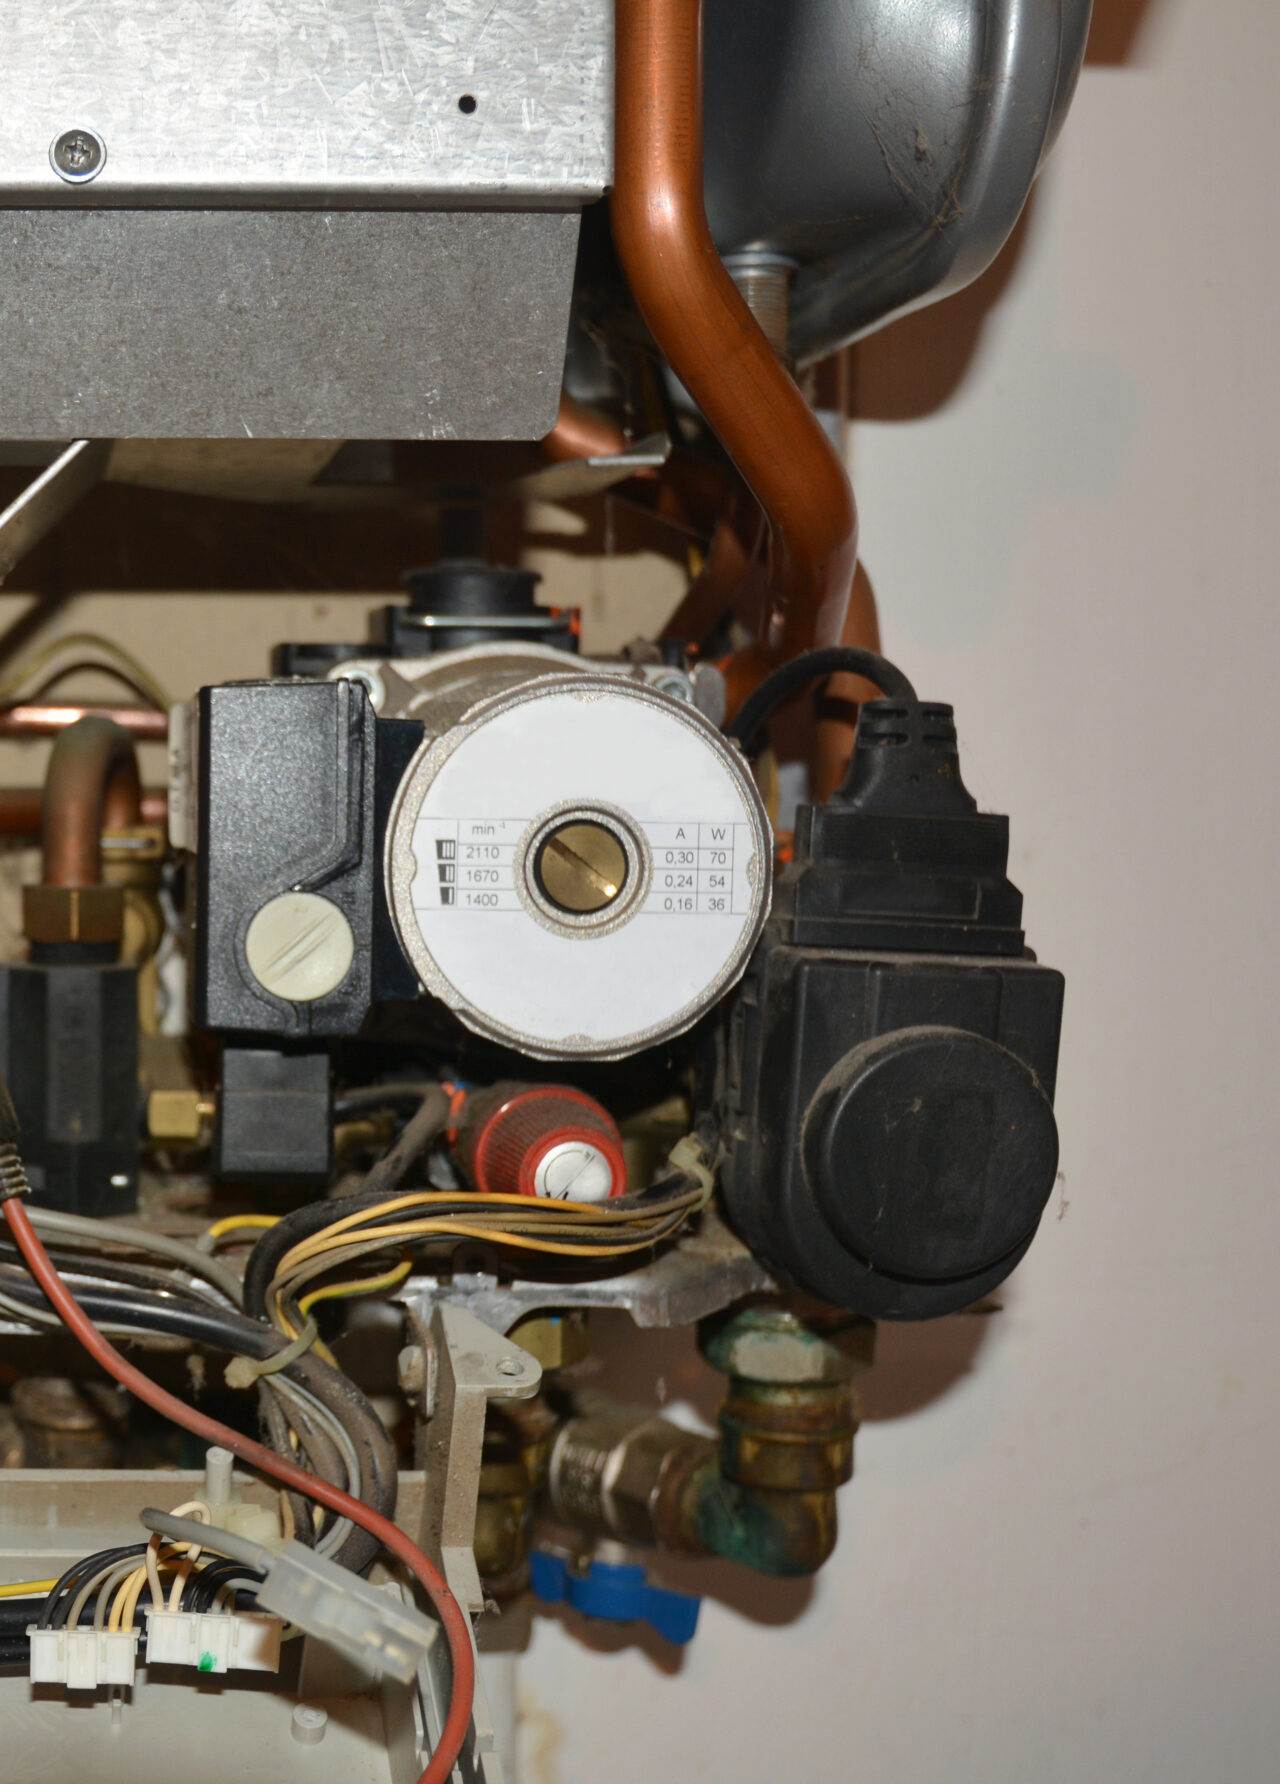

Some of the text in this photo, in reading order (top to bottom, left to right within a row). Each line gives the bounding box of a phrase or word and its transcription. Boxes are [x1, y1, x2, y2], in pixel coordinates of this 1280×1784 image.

[471, 824, 495, 836] min
[675, 827, 726, 840] A W
[466, 846, 500, 860] 2110
[665, 850, 727, 865] 0,30 70
[466, 869, 499, 883] 1670
[664, 874, 726, 889] 0,24 54
[466, 893, 499, 907] 1400
[663, 897, 726, 912] 0,16 36
